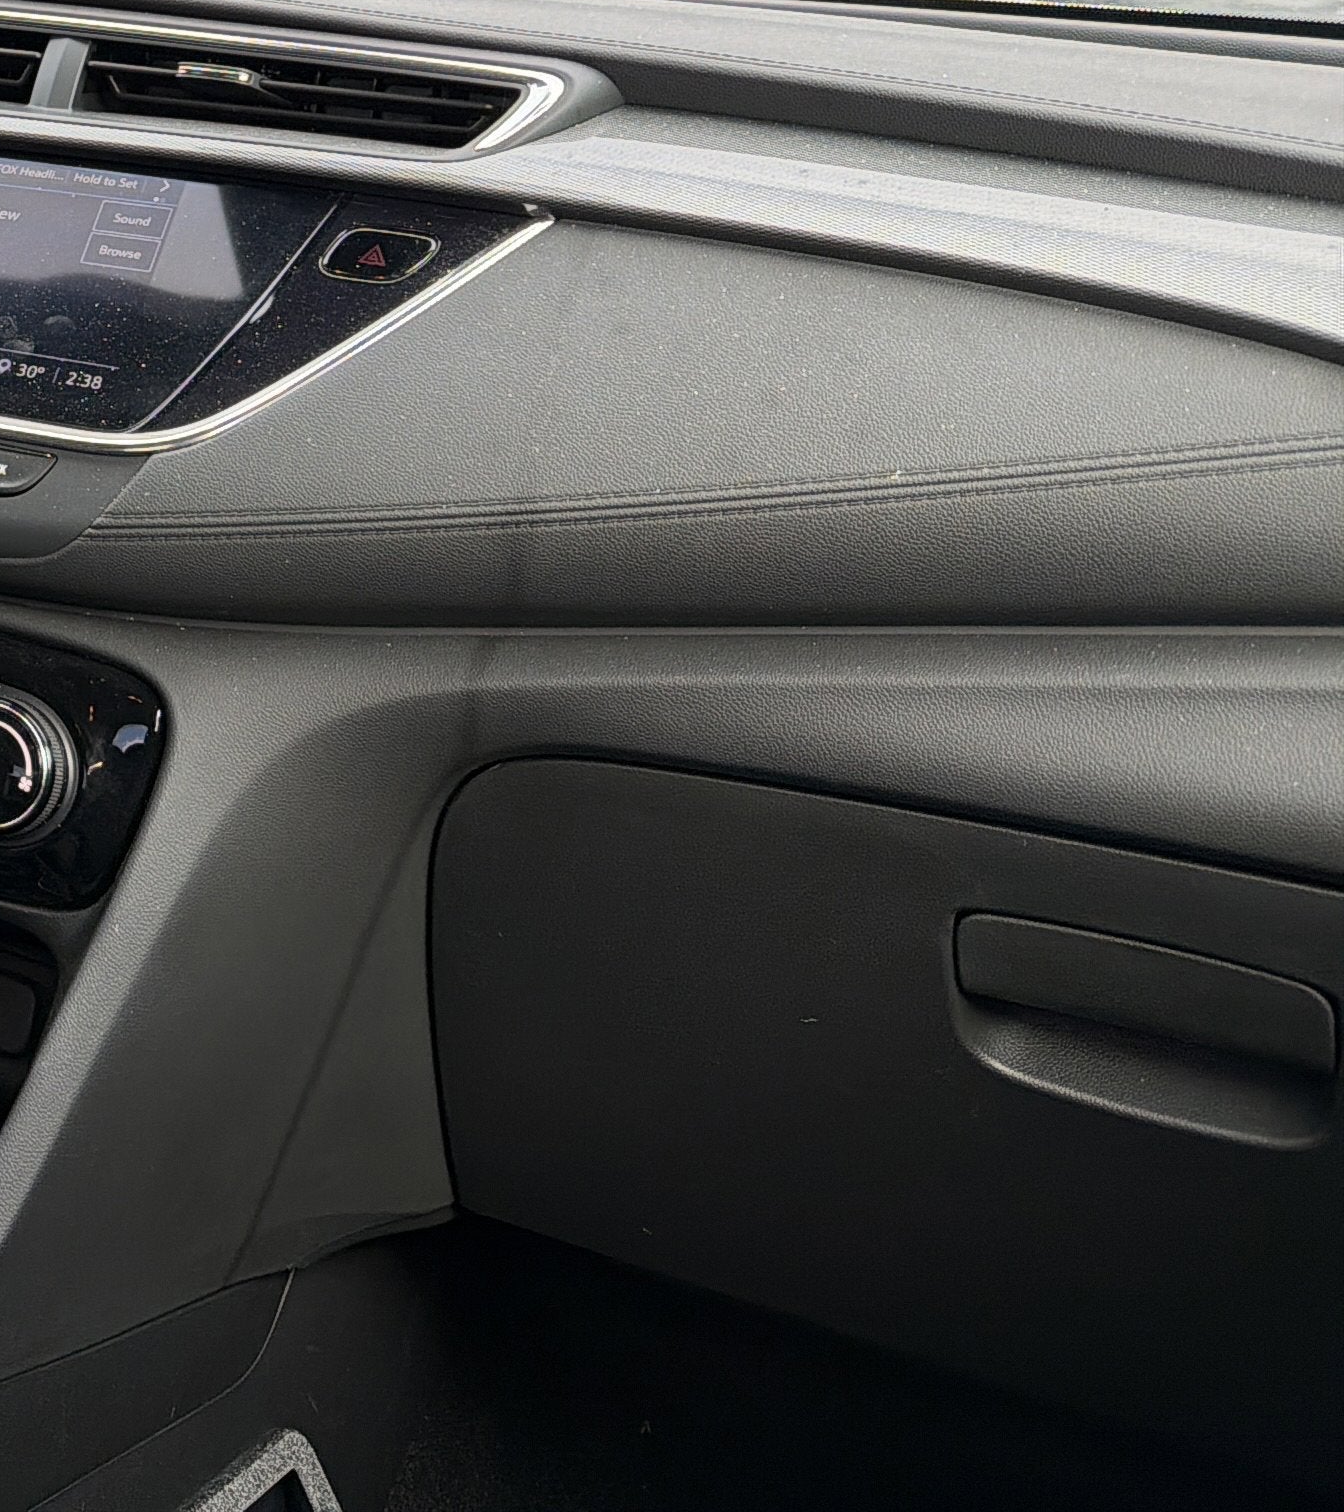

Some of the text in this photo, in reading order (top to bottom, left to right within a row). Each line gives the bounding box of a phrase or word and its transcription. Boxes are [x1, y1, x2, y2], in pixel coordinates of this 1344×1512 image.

[73, 172, 139, 190] Hold to Set
[112, 211, 153, 228] Sound
[98, 243, 143, 261] Browse
[15, 363, 46, 380] 30°
[65, 371, 104, 390] 2:38
